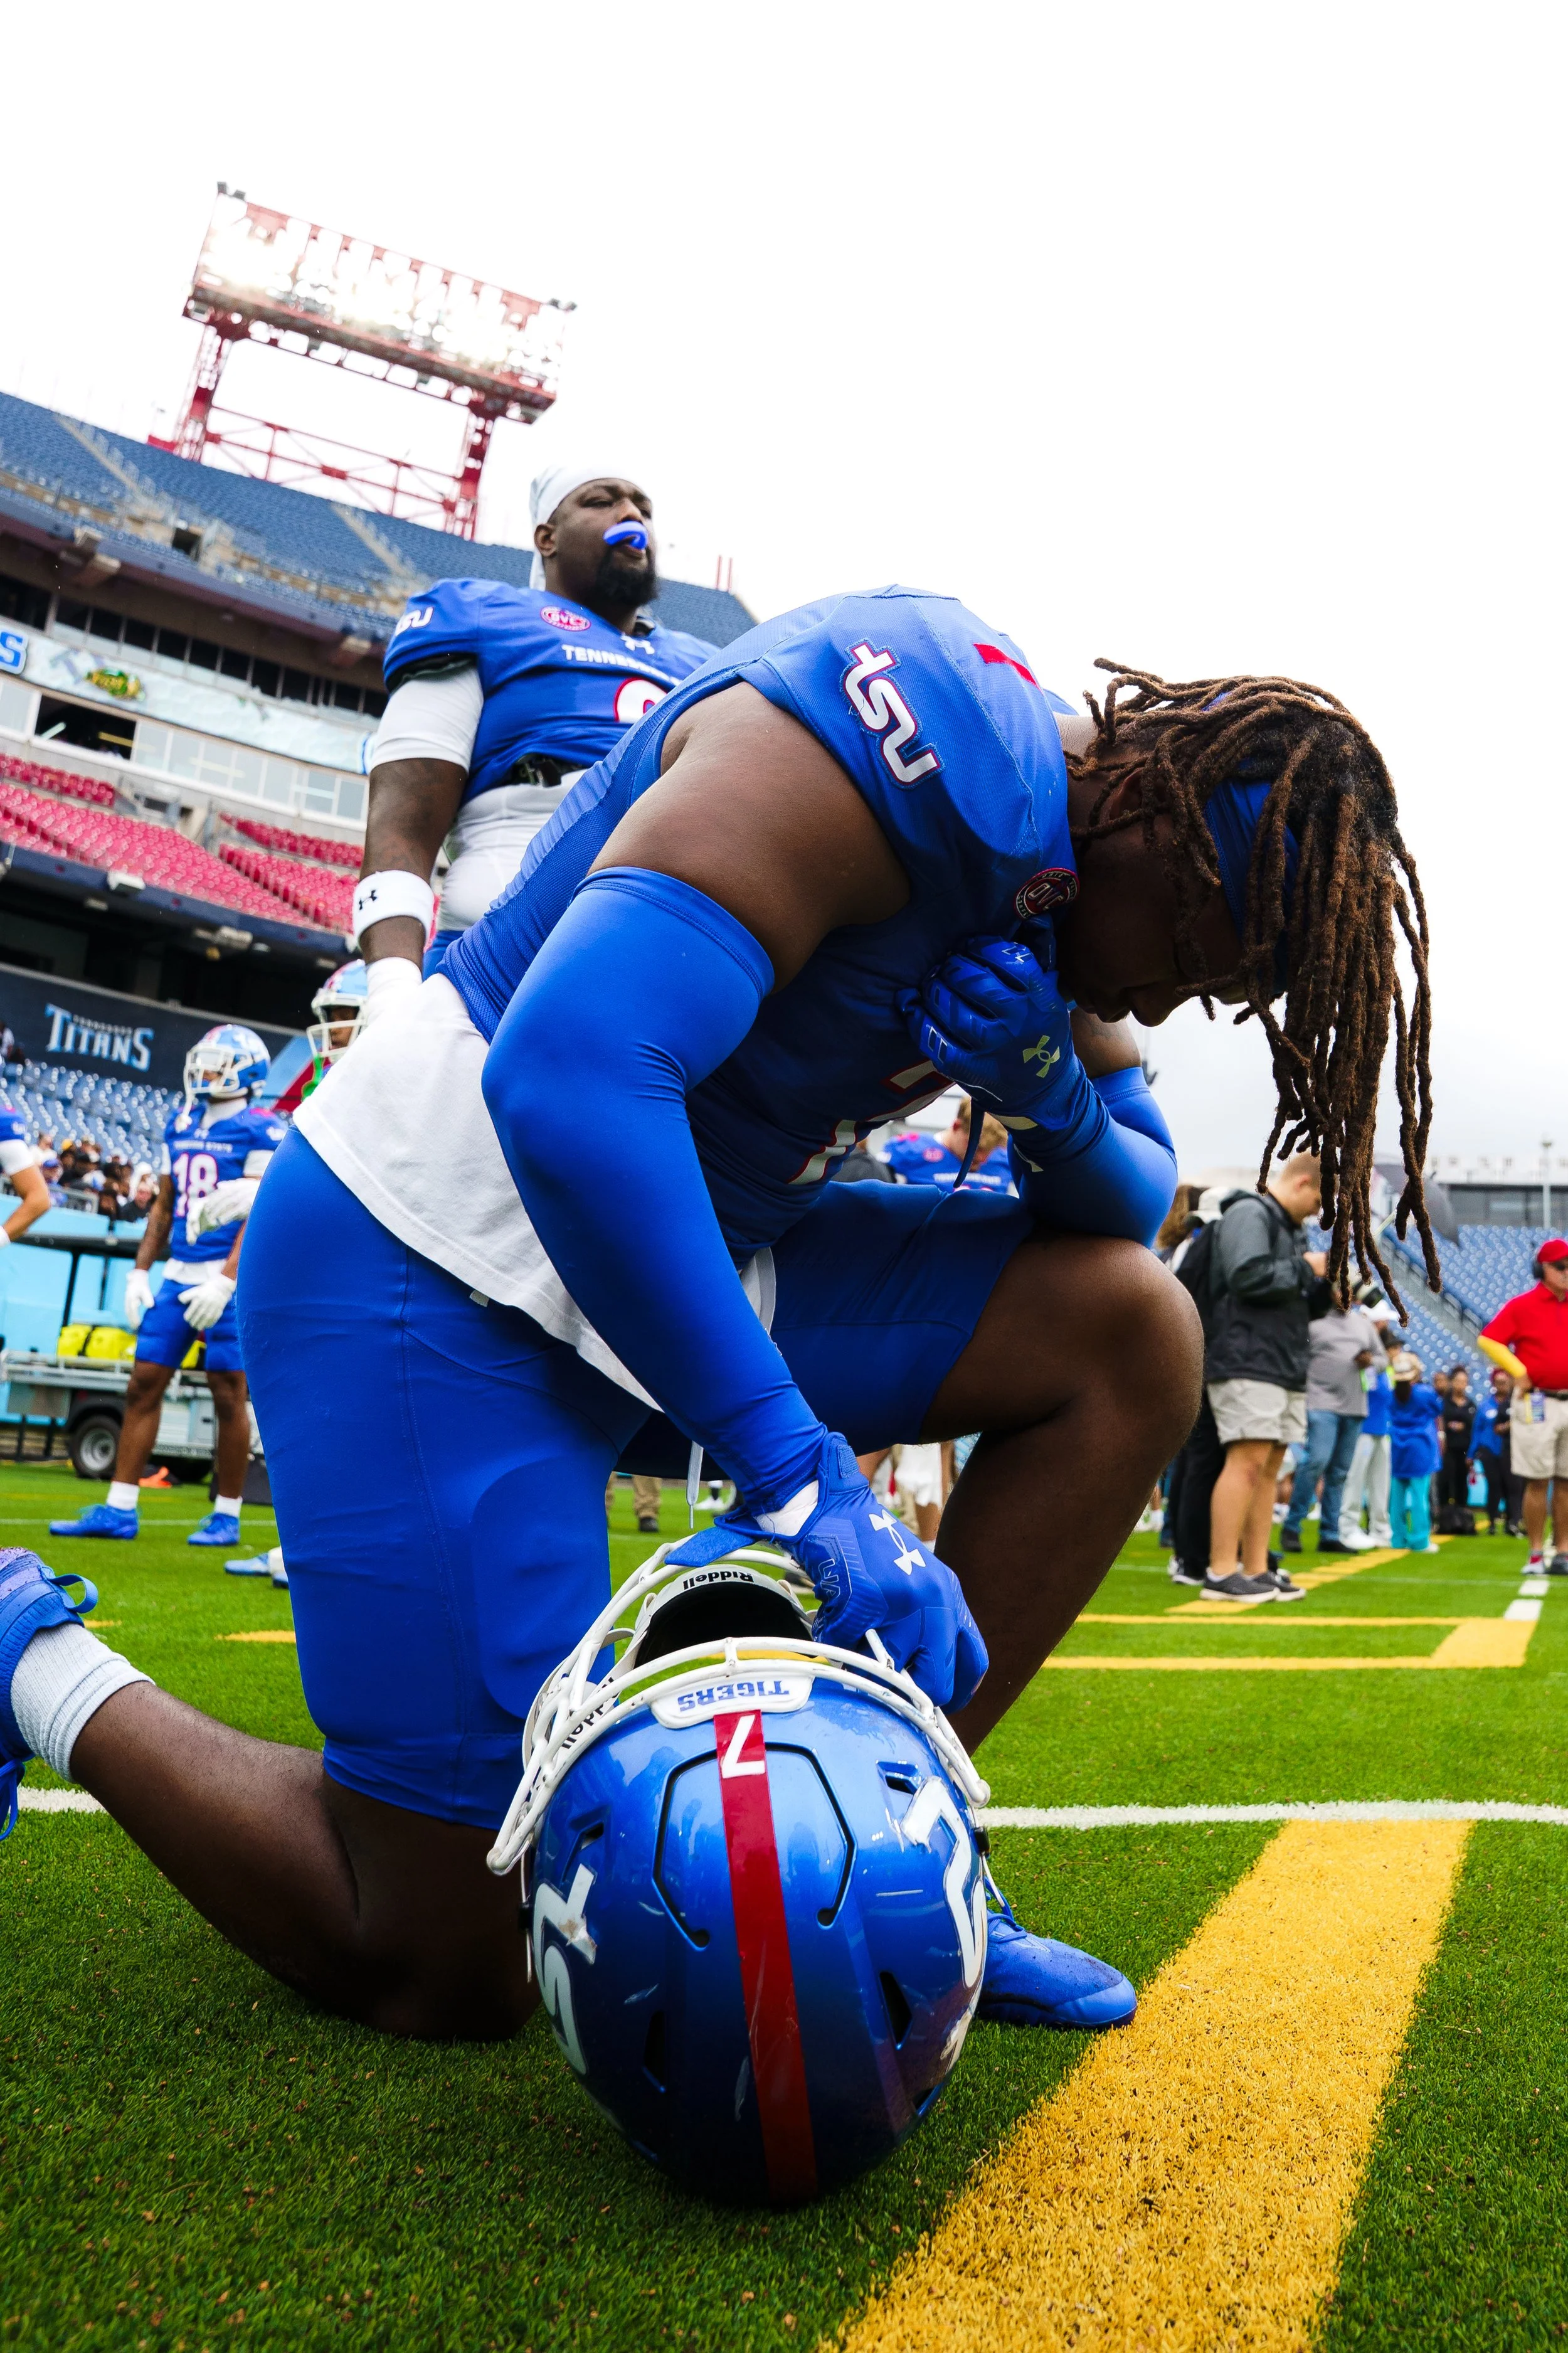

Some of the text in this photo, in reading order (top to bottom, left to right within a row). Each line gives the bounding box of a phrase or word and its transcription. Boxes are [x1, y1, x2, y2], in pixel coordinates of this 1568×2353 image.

[45, 1003, 154, 1072] TITANS
[172, 1152, 218, 1217] 18
[682, 1570, 755, 1591] Riddell
[677, 1681, 790, 1712] TIGERS
[721, 1714, 766, 1779] 7
